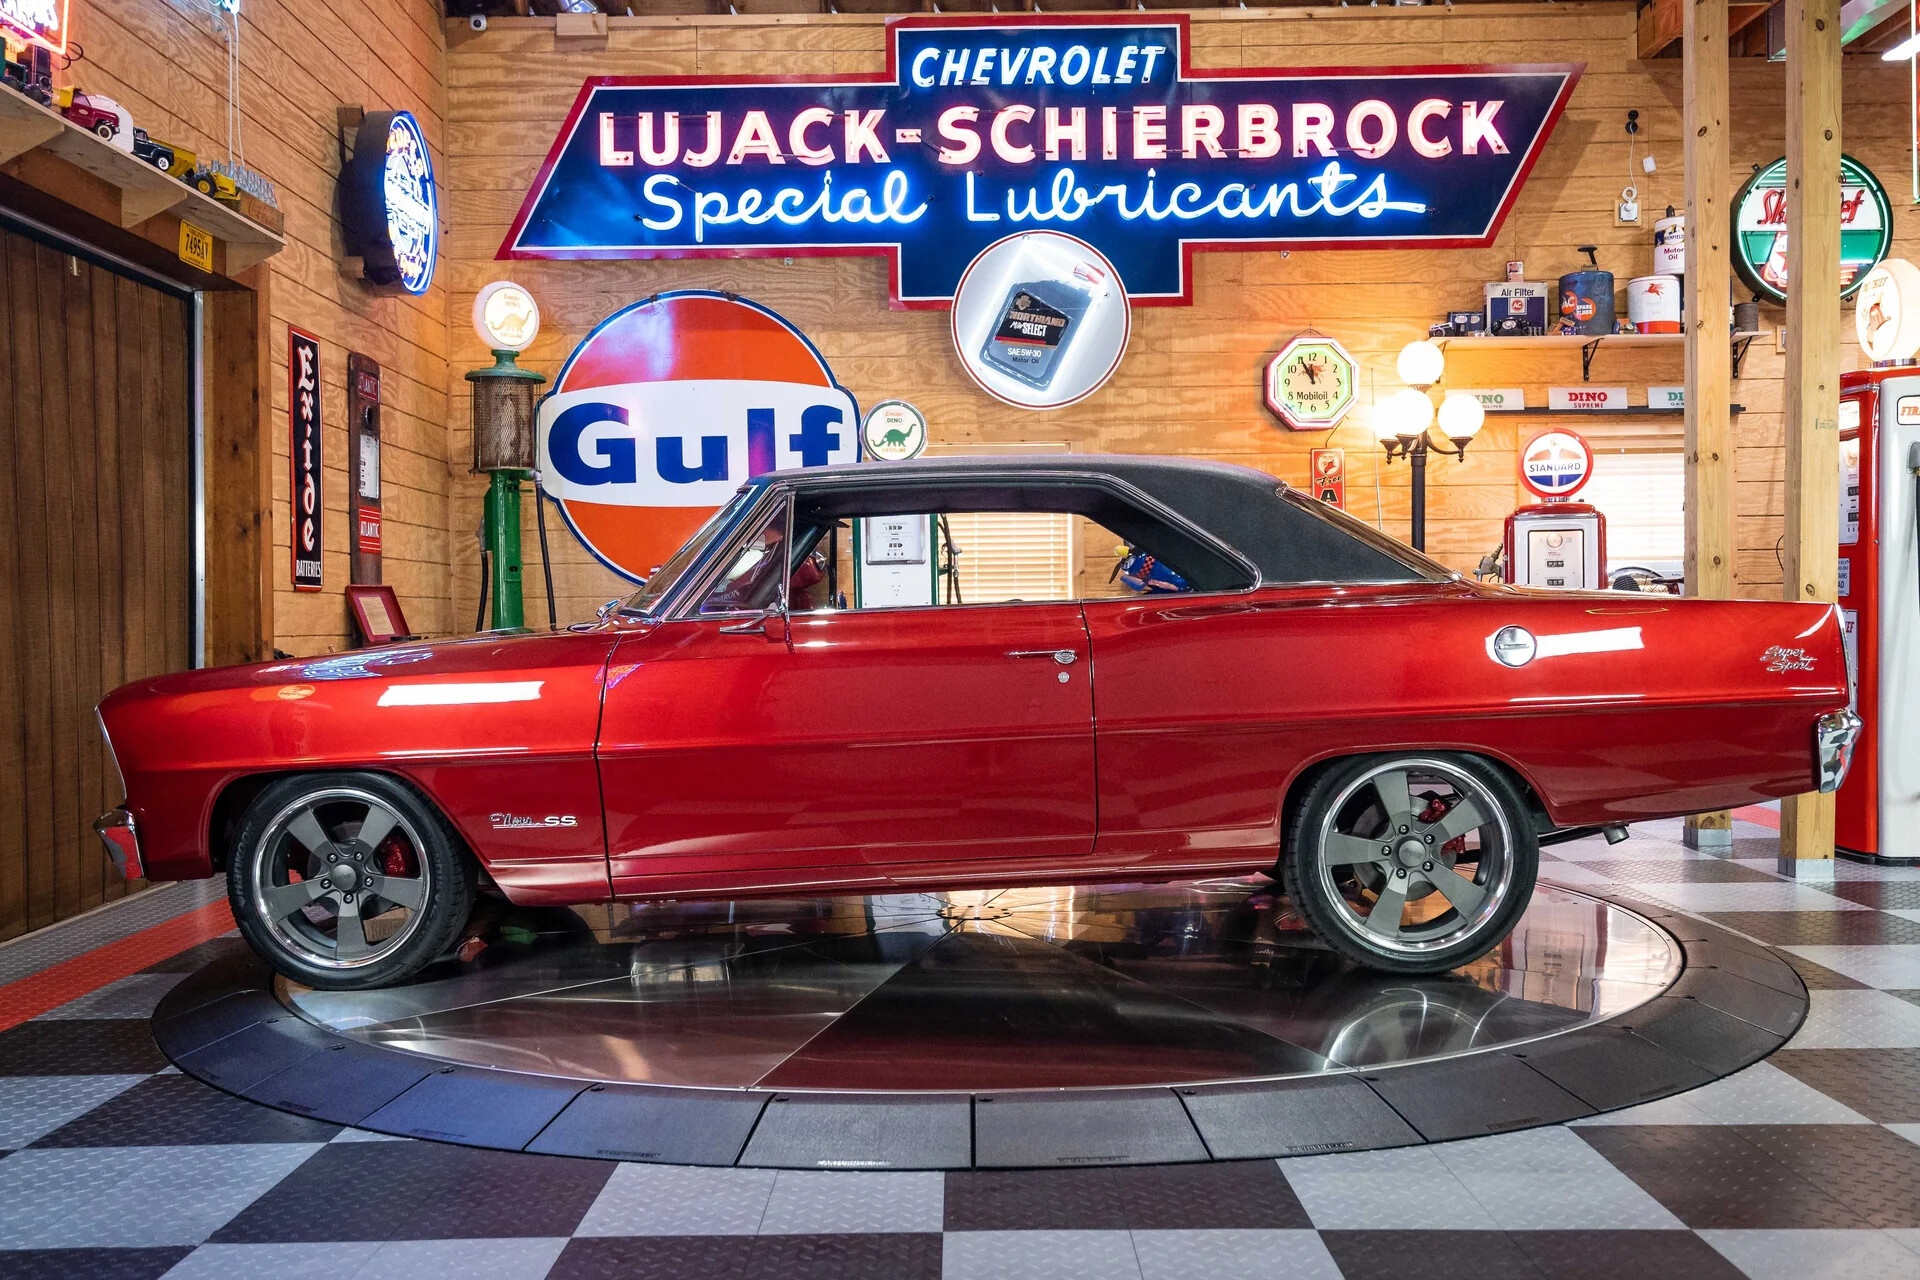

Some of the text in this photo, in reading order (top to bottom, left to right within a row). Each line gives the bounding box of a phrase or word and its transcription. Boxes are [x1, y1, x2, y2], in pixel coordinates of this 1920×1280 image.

[911, 45, 1166, 87] CHEVROLET
[599, 99, 1511, 167] LUJACK-SCHIERBROCK
[633, 160, 1431, 243] Special Lubricants
[1501, 288, 1535, 297] Air Filter
[1561, 296, 1575, 308] AC
[1022, 322, 1048, 337] SELECT
[1007, 347, 1042, 358] SAE 5W-30
[1308, 352, 1317, 362] 12
[1287, 364, 1338, 374] 10 2
[1284, 378, 1342, 387] 9 3
[1287, 391, 1338, 401] 8 Mobiloil 4
[1475, 394, 1505, 404] INO
[1568, 391, 1608, 402] DINO
[1297, 400, 1330, 412] 7 6 5
[547, 402, 844, 486] Gulf
[1529, 462, 1582, 473] STANDARD
[1315, 475, 1343, 487] Free
[360, 521, 380, 539] ATLANTIC
[296, 558, 322, 579] BATTERIES
[1760, 645, 1806, 662] Super
[1766, 655, 1818, 675] Sport
[544, 815, 577, 827] SS
